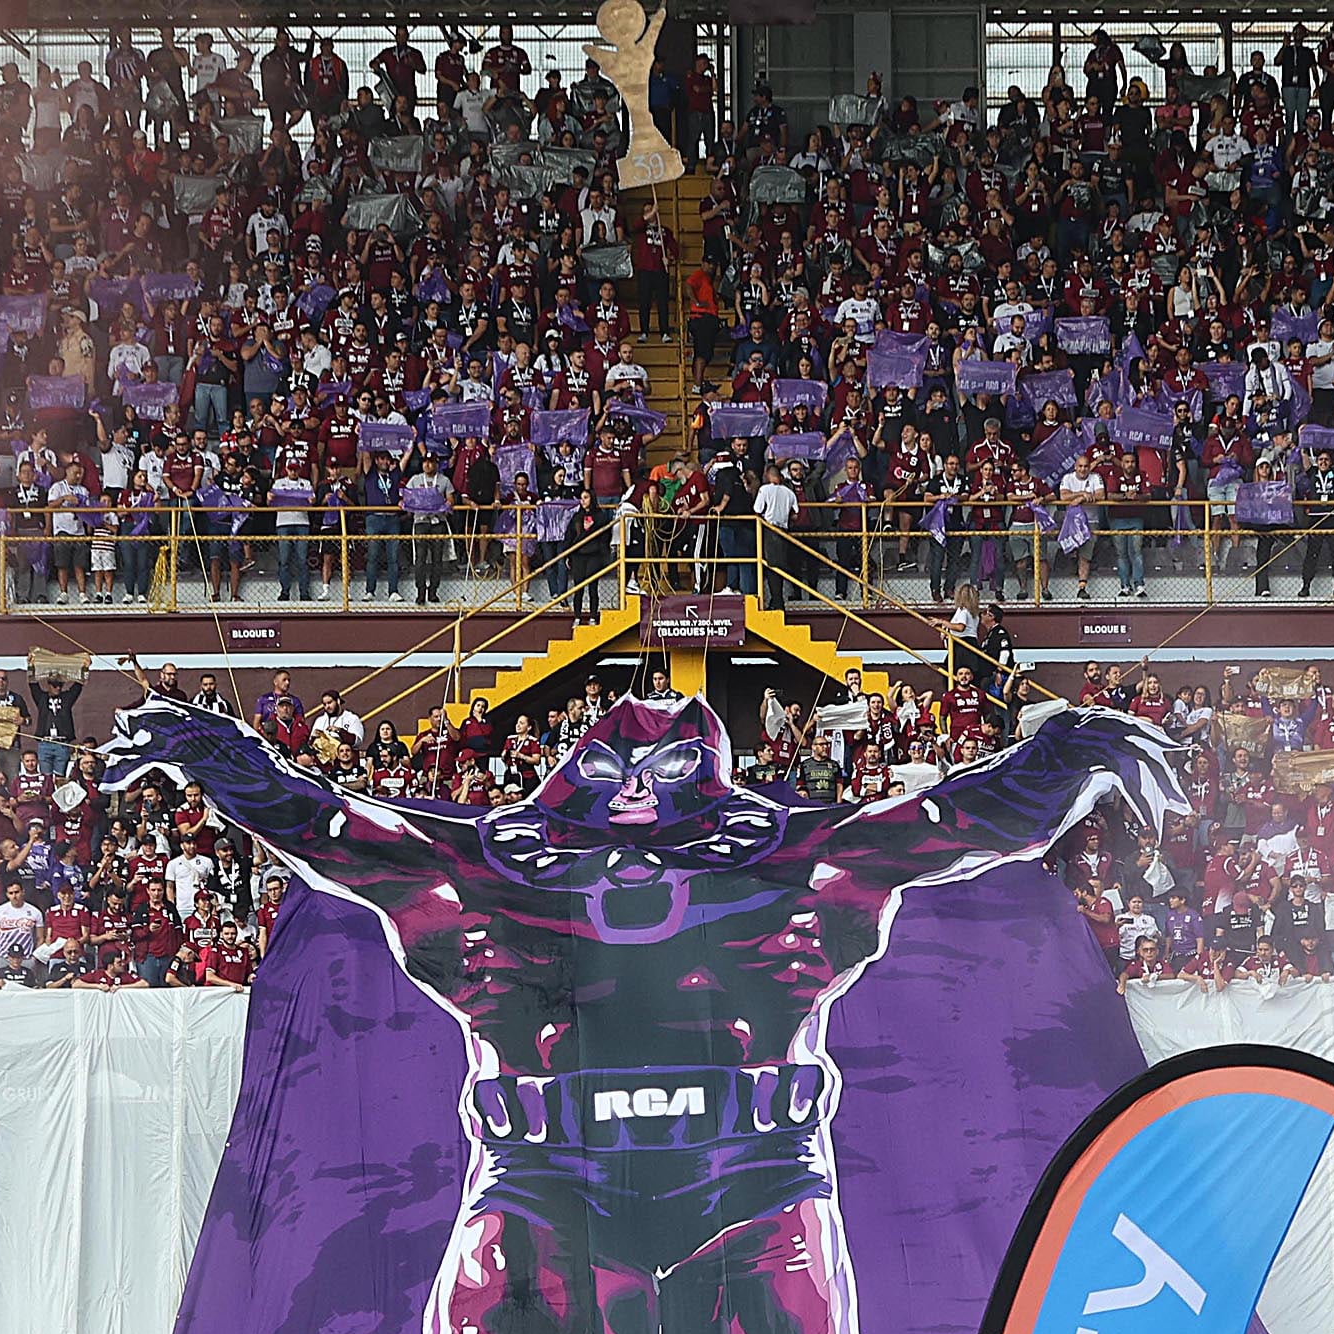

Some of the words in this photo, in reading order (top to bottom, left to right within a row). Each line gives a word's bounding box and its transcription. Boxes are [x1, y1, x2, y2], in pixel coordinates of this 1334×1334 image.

[634, 152, 665, 182] 39
[232, 630, 267, 639] BLOQUE
[268, 630, 276, 638] D
[658, 627, 705, 638] (BLOQUES
[707, 627, 728, 638] H-E)
[1084, 625, 1120, 634] BLOQUE
[1120, 626, 1126, 634] E
[594, 1086, 706, 1122] RCA
